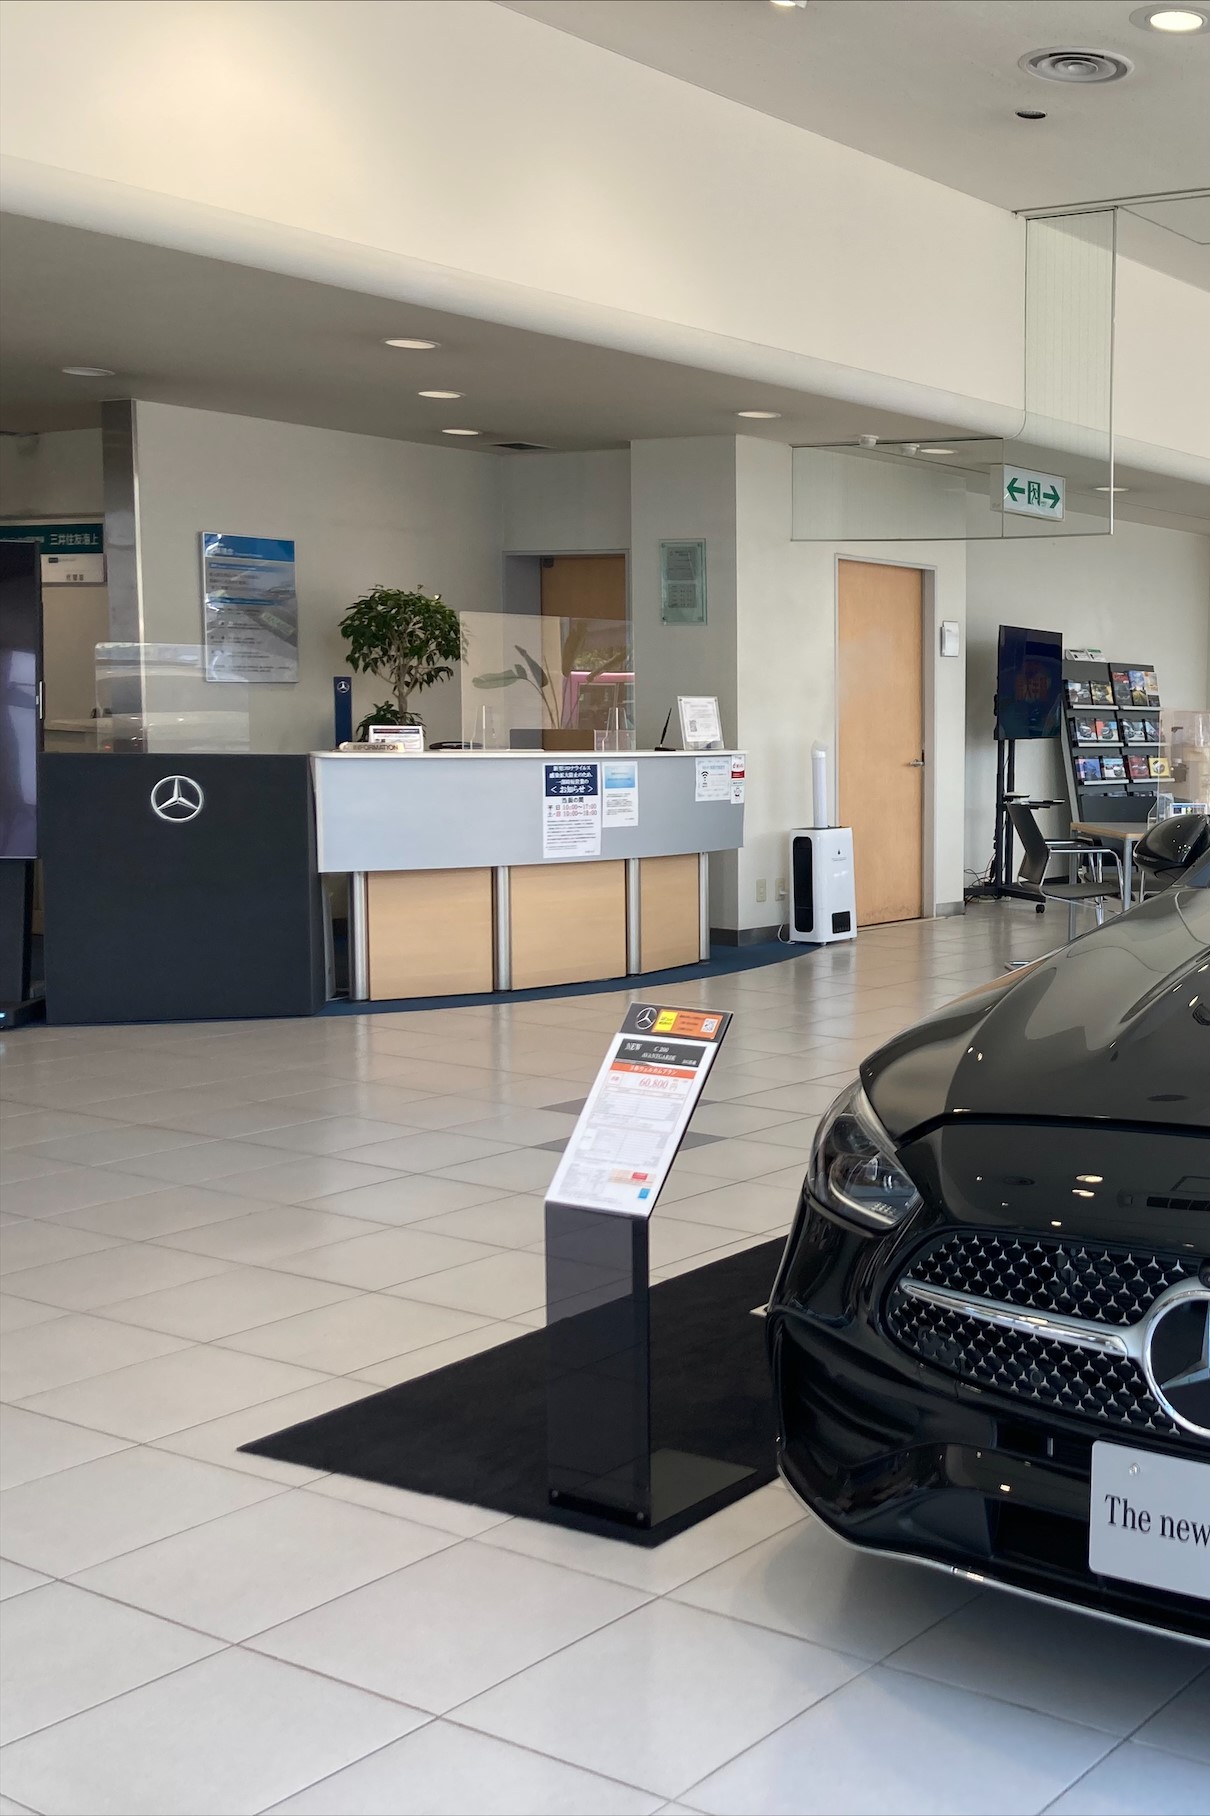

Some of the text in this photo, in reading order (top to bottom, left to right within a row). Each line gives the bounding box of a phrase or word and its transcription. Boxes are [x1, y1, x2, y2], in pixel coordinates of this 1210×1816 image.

[50, 533, 99, 546] 三井住友海上
[624, 1042, 642, 1051] NEW
[1104, 1493, 1152, 1534] The
